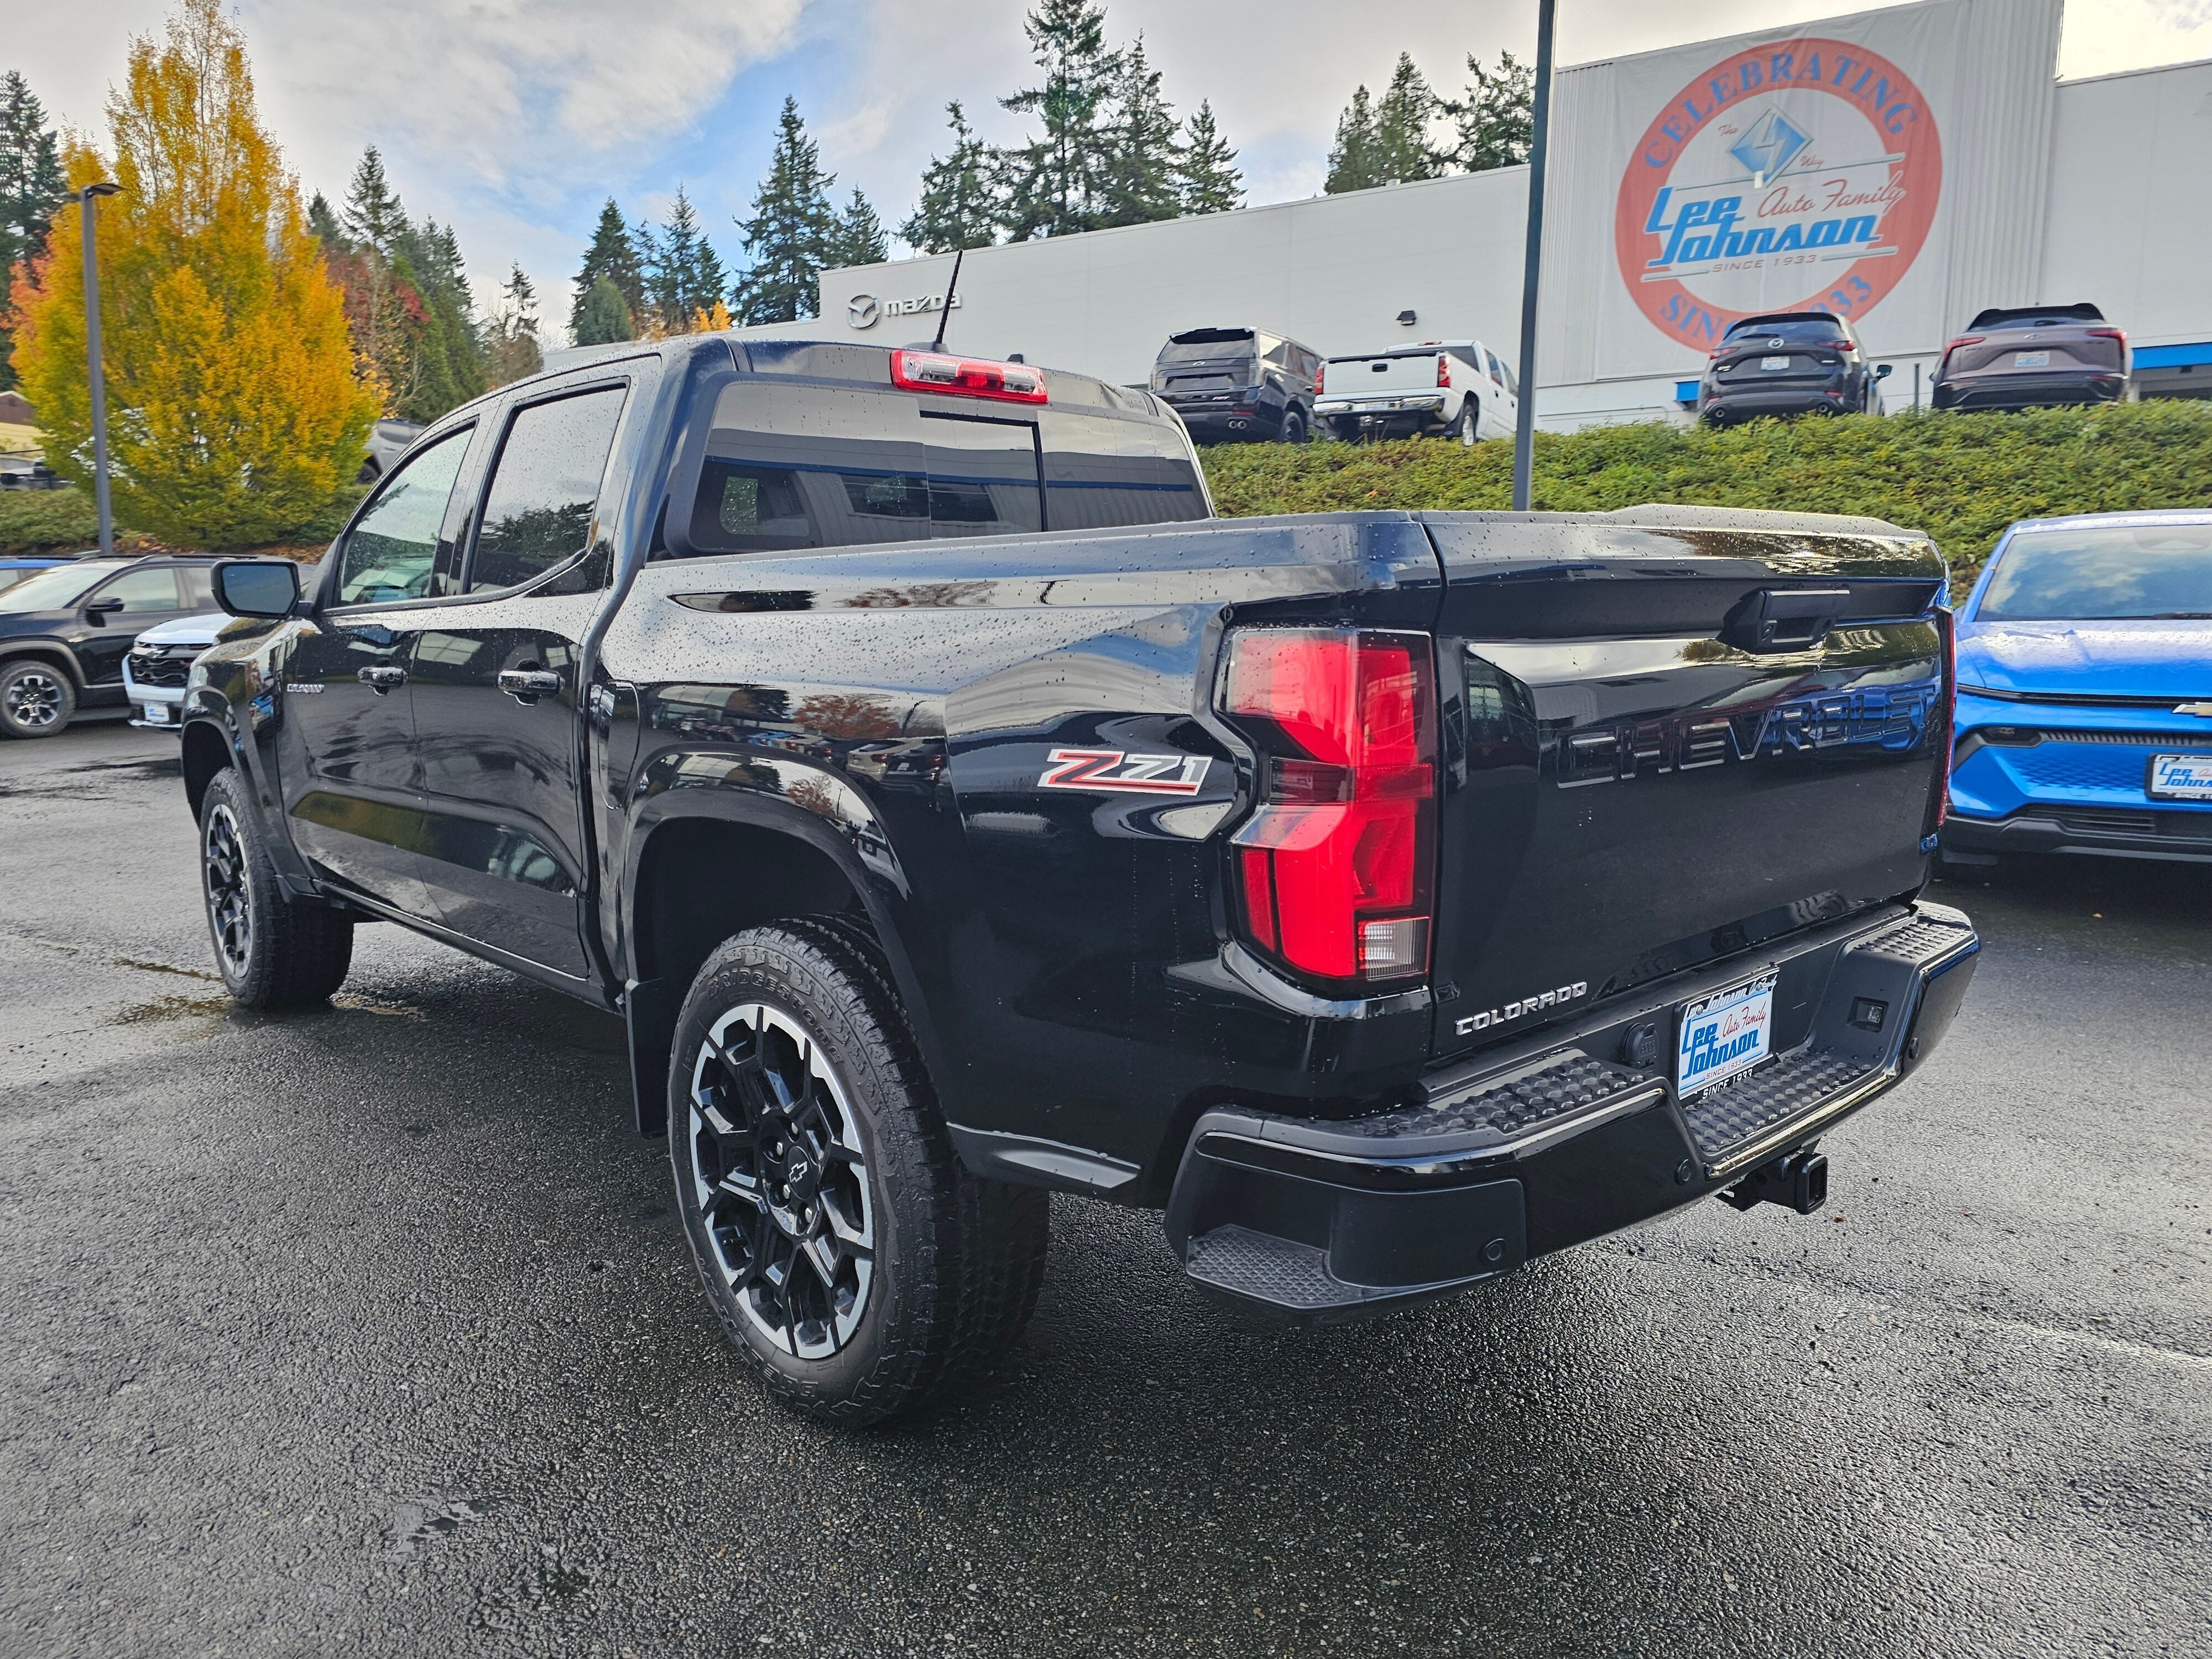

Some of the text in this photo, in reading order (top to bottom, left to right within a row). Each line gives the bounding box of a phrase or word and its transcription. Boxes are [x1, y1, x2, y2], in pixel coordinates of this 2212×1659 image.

[1644, 51, 1918, 168] CELEBRATING
[1717, 124, 1739, 137] The
[1646, 170, 1906, 232] Lee Auto Family
[1647, 213, 1882, 267] Johnson
[1712, 254, 1817, 273] SINCE 1933
[1661, 294, 1738, 342] SIN
[1037, 749, 1213, 796] Z71
[2158, 763, 2194, 777] Lee
[2159, 774, 2212, 787] Johns
[707, 967, 843, 1064] BRIDGESTONE
[1455, 981, 1587, 1035] COLORADO
[1702, 988, 1747, 1013] Johnson
[1682, 1000, 1767, 1055] Lee Auto Family
[1682, 1029, 1760, 1081] Johnson
[1705, 1059, 1742, 1079] SINCE 1933
[1703, 1068, 1752, 1099] SINCE 1933
[718, 1305, 819, 1399] DUELER
